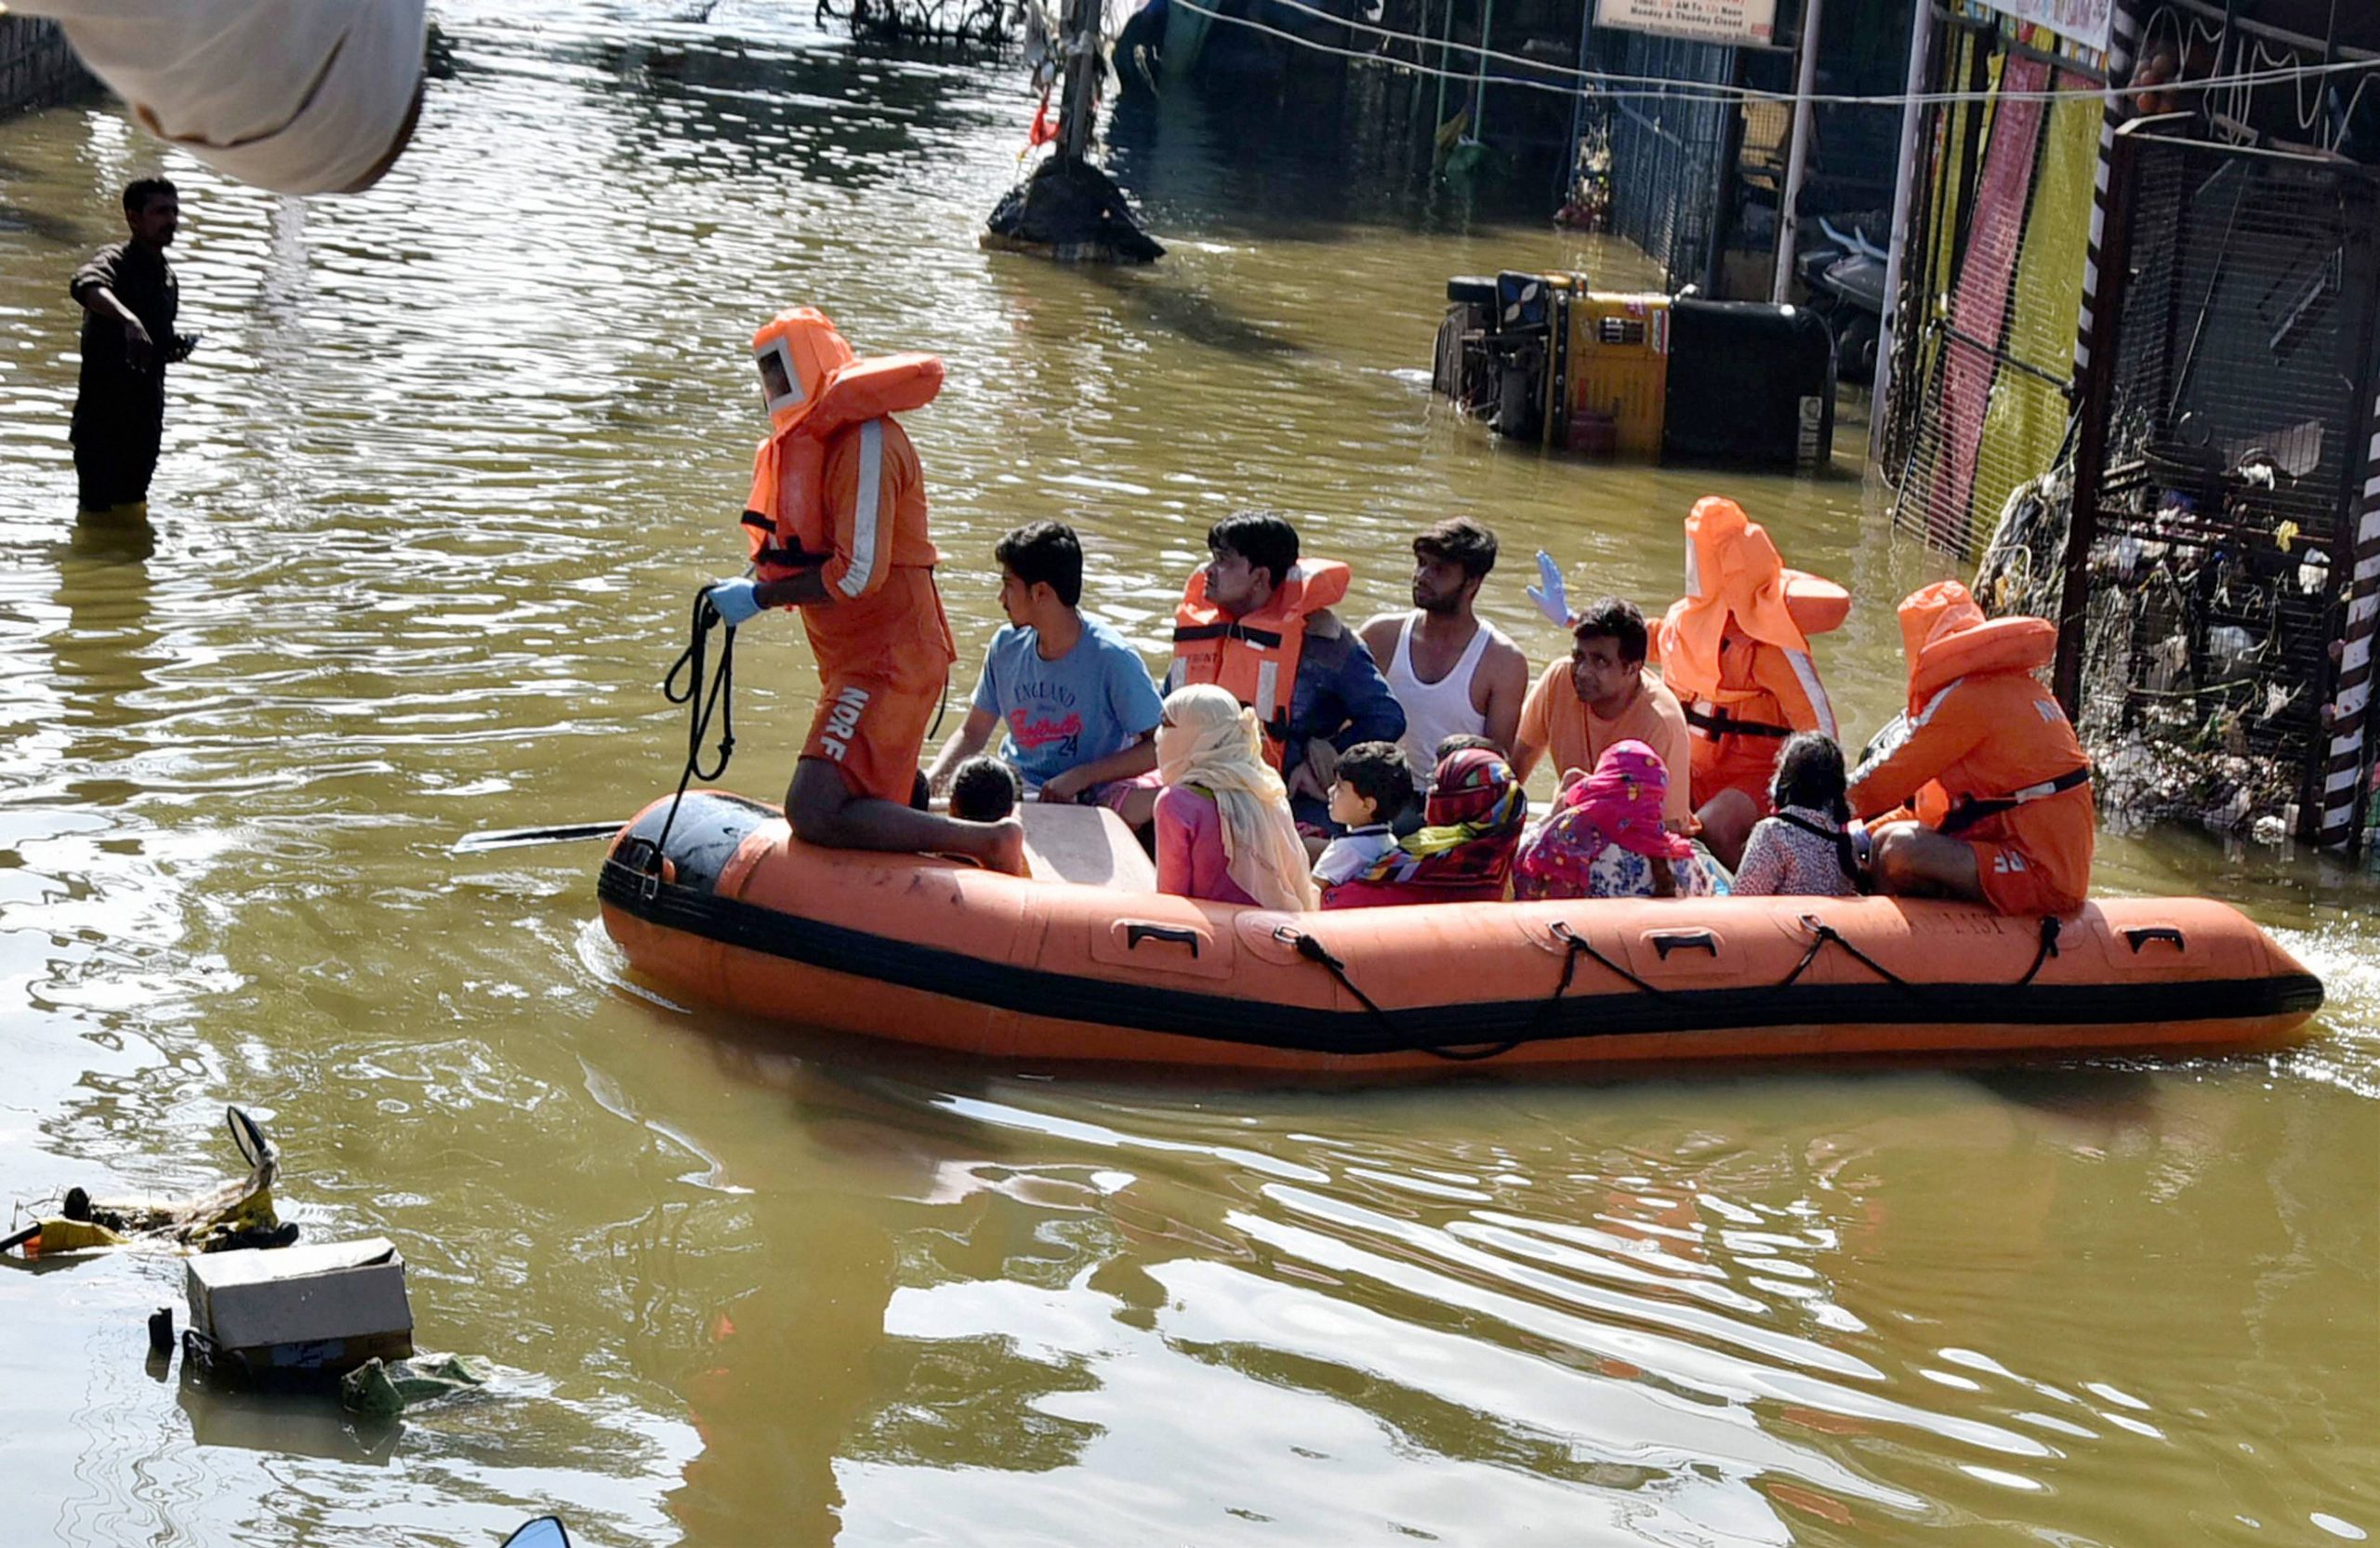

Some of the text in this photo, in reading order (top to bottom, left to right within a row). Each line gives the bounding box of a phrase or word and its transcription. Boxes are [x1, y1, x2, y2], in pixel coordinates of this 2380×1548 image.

[1630, 7, 1663, 20] Monday
[1713, 15, 1743, 28] Closed
[1675, 0, 1689, 9] AM
[1721, 6, 1743, 16] Noon
[1013, 681, 1077, 708] ENGLAND
[819, 685, 871, 762] NDRF
[1057, 734, 1079, 758] 24
